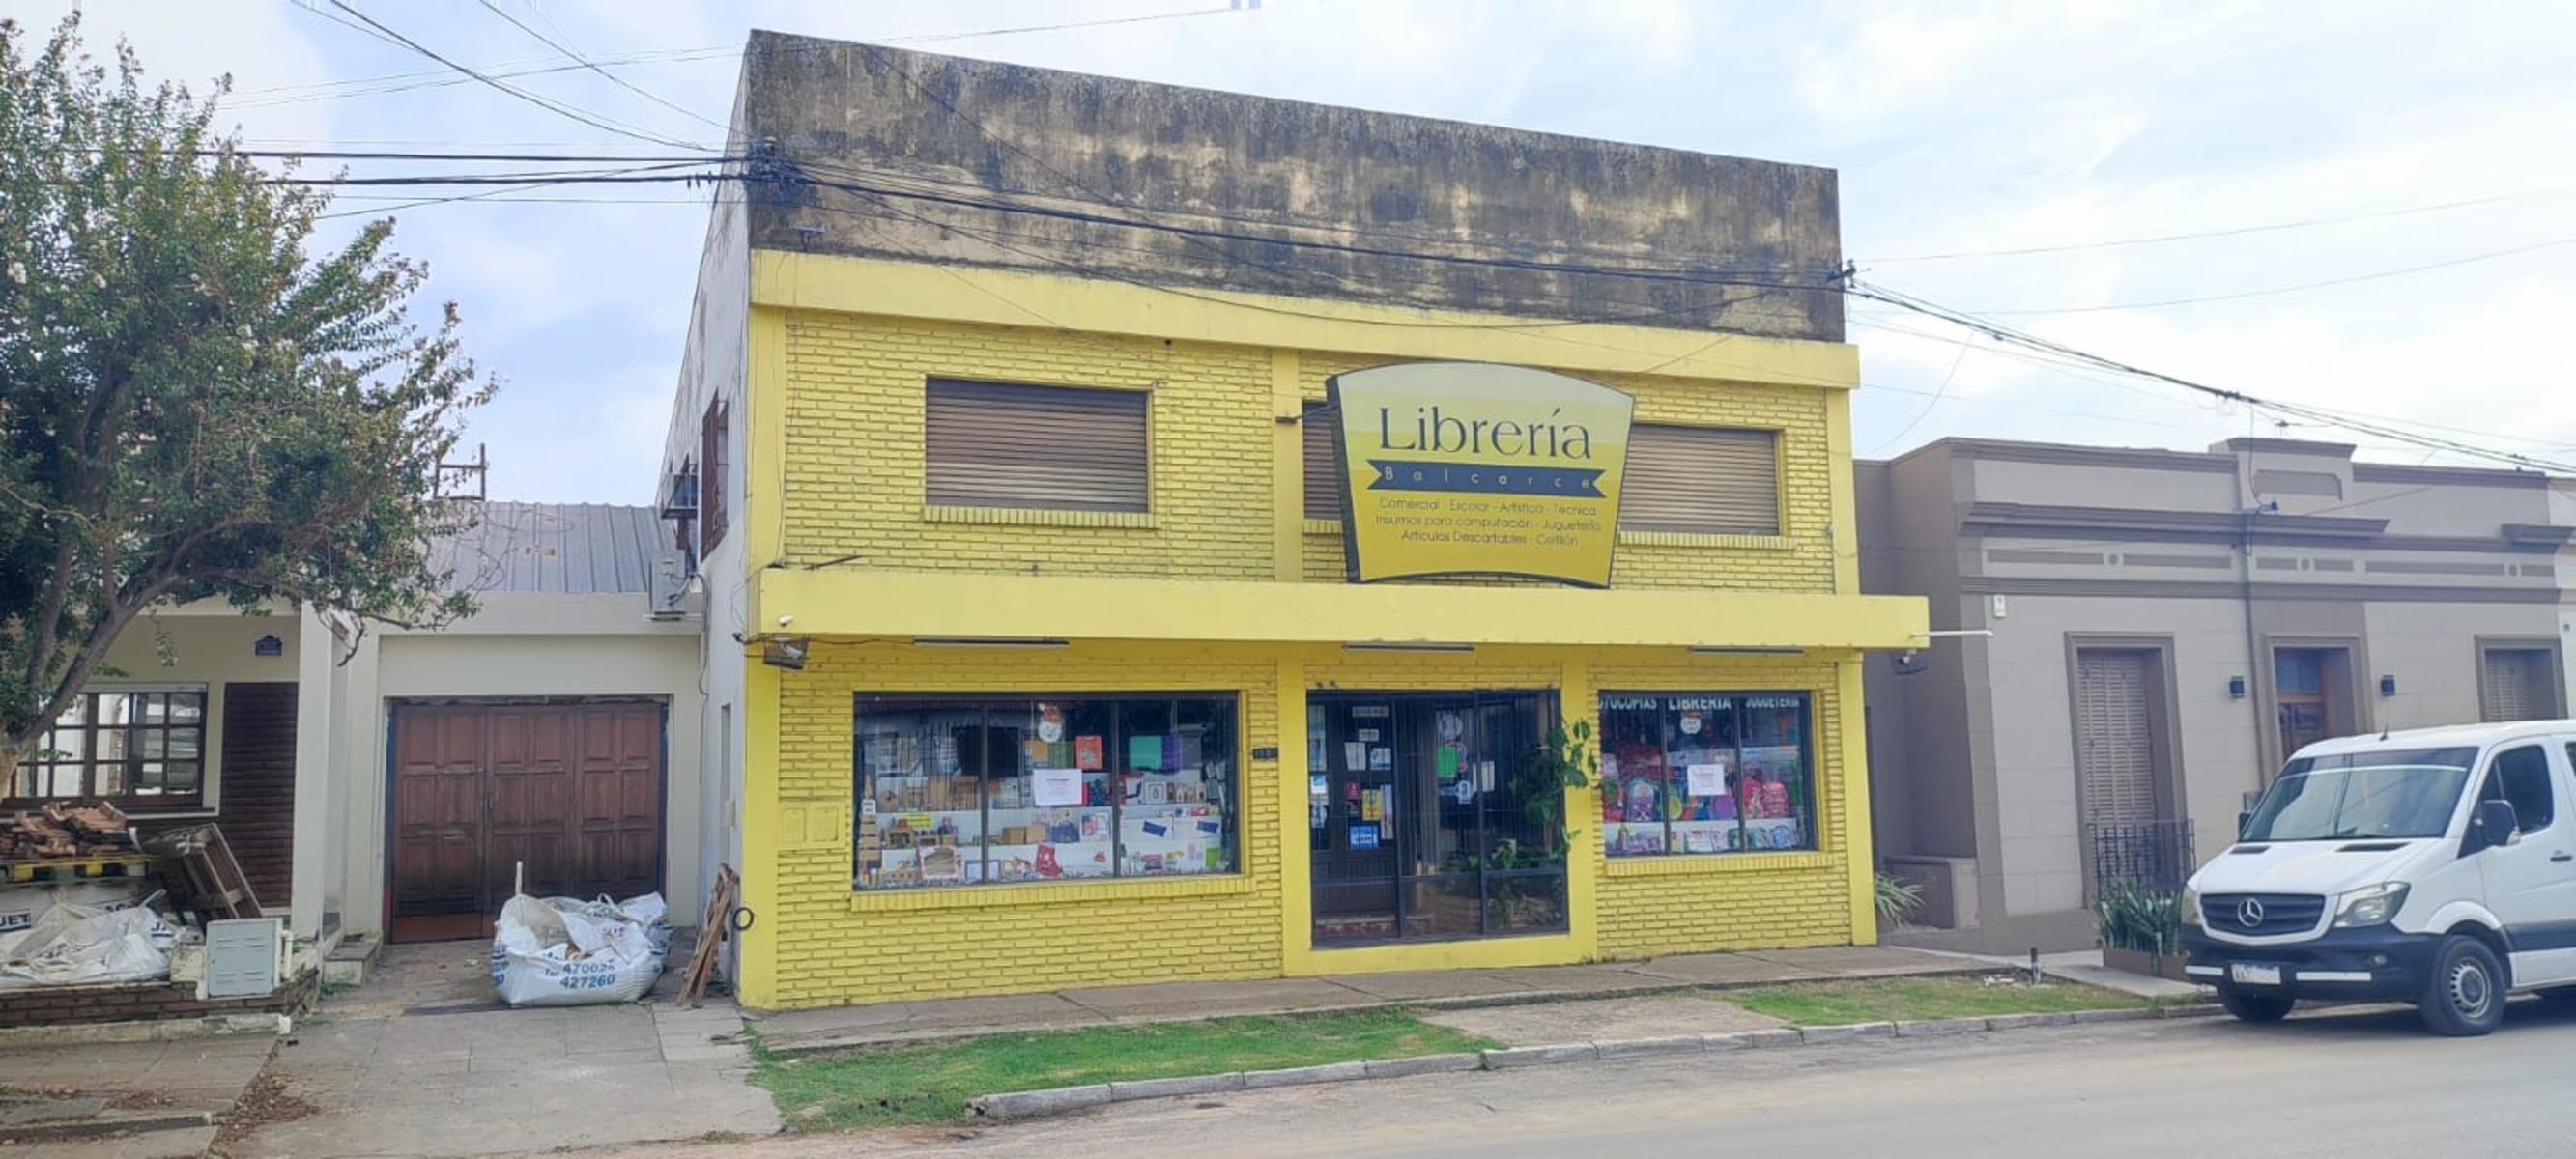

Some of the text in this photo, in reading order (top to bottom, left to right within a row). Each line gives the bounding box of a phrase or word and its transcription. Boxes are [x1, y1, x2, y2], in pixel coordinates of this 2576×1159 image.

[1380, 407, 1591, 460] Librería
[1385, 466, 1589, 489] Balcarce
[1379, 497, 1441, 511] Comercial
[1449, 499, 1490, 513] Escolar
[1376, 514, 1422, 526] Insumos
[1452, 531, 1528, 544] Descartables
[559, 975, 616, 989] 427260
